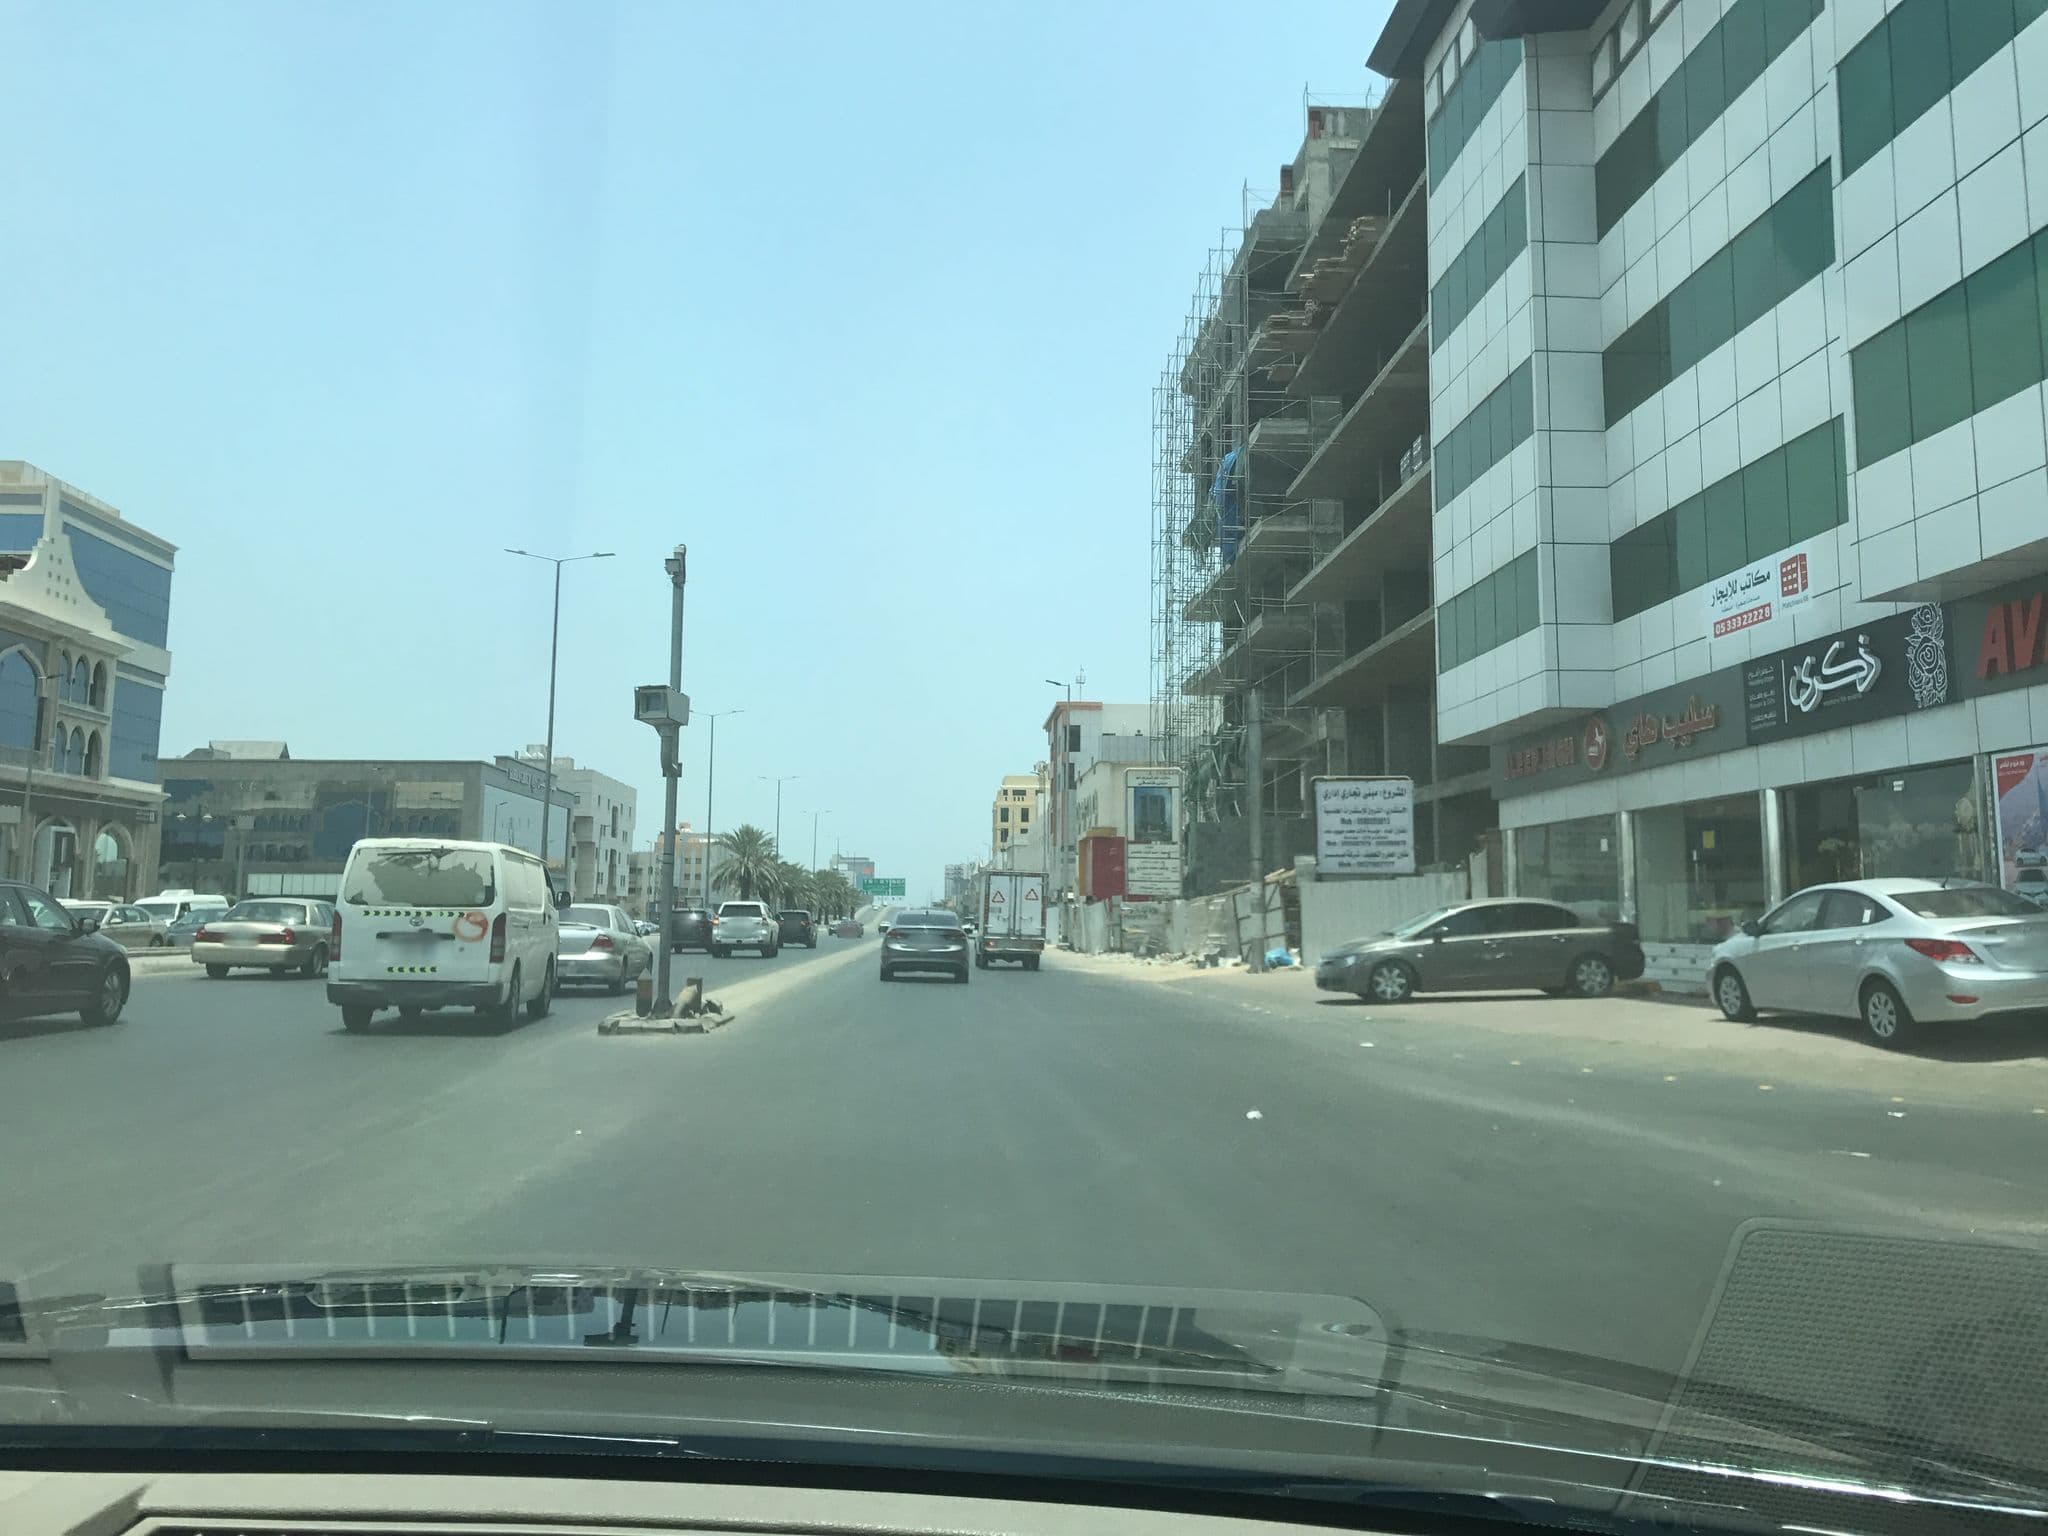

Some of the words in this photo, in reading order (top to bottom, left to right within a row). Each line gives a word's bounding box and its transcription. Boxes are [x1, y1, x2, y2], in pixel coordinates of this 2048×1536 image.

[1740, 569, 1771, 595] مكاتب
[1976, 592, 2048, 680] AV
[1789, 634, 1882, 713] ذكرى
[1662, 695, 1718, 749] سليب
